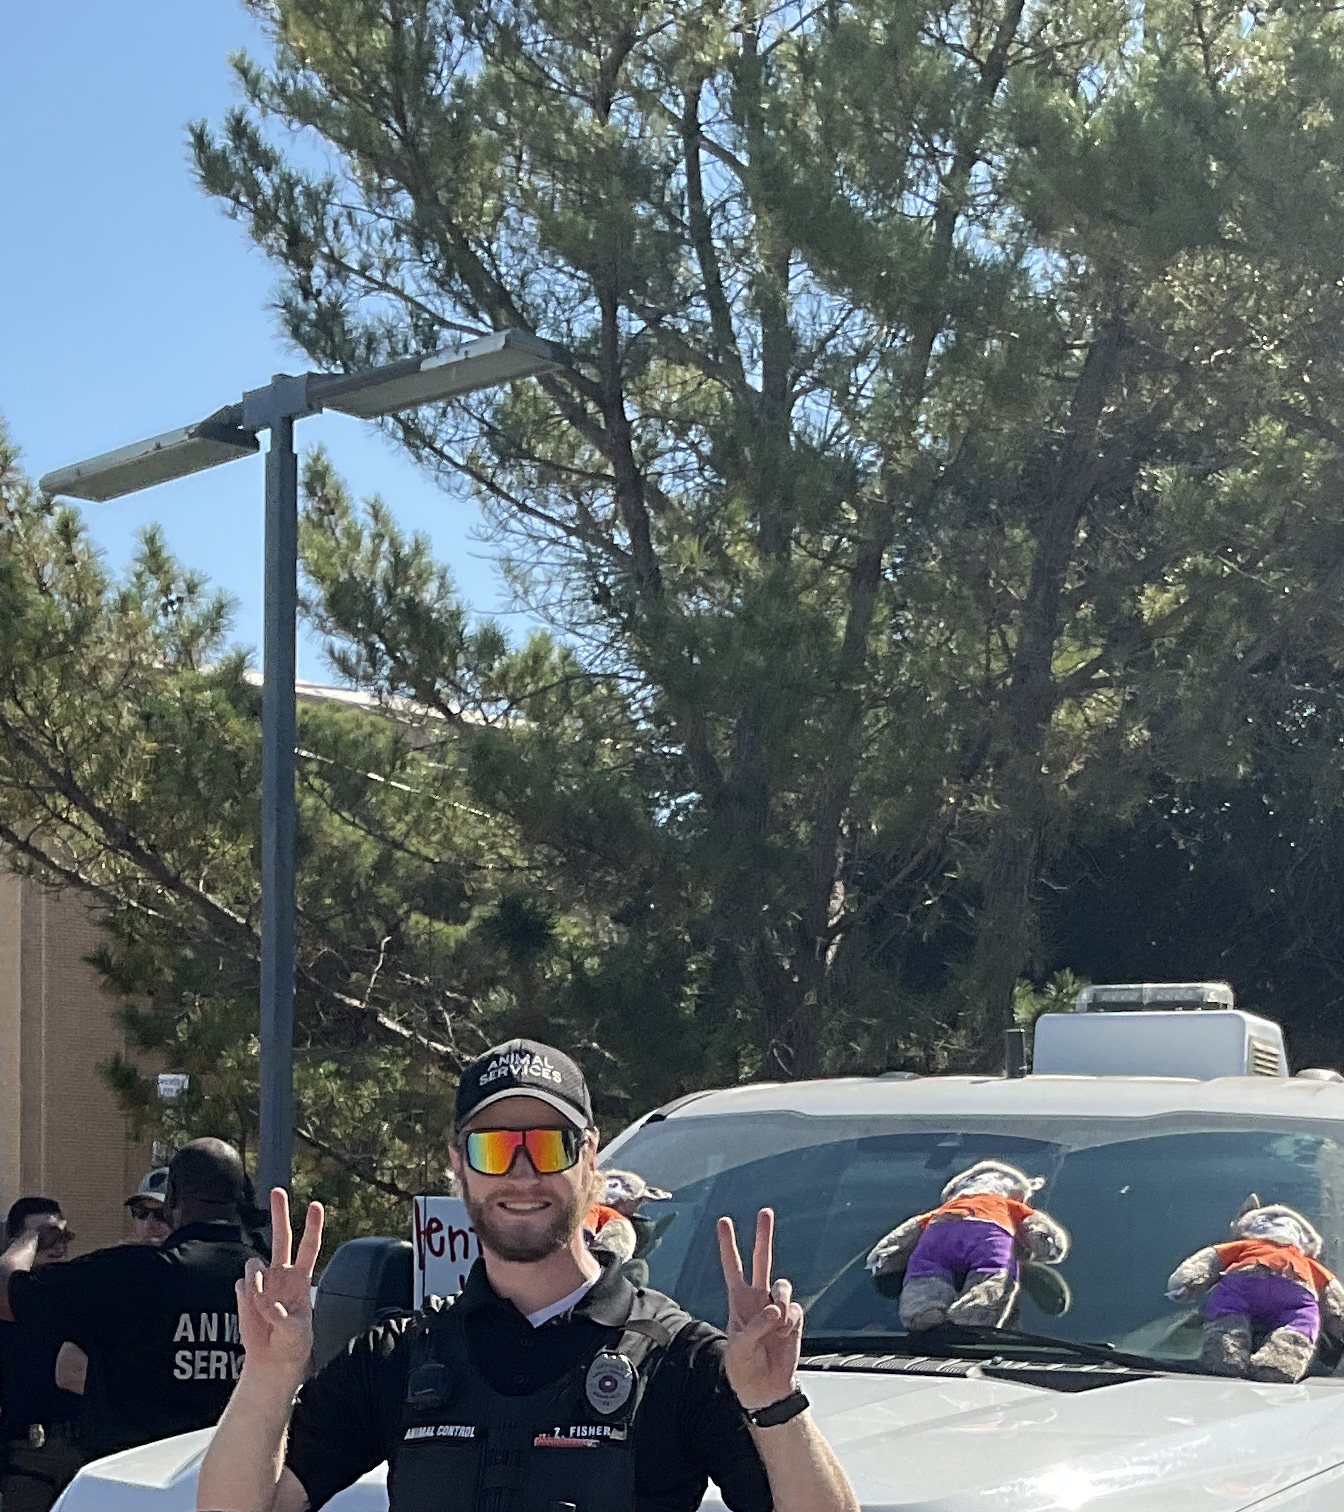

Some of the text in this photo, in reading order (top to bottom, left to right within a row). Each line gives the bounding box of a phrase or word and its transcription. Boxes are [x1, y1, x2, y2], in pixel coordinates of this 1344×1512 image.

[487, 1052, 554, 1072] ANIMAL
[479, 1064, 562, 1086] SERVICES
[404, 1425, 475, 1440] ANIMAL CONTROL
[569, 1426, 611, 1438] FISHER
